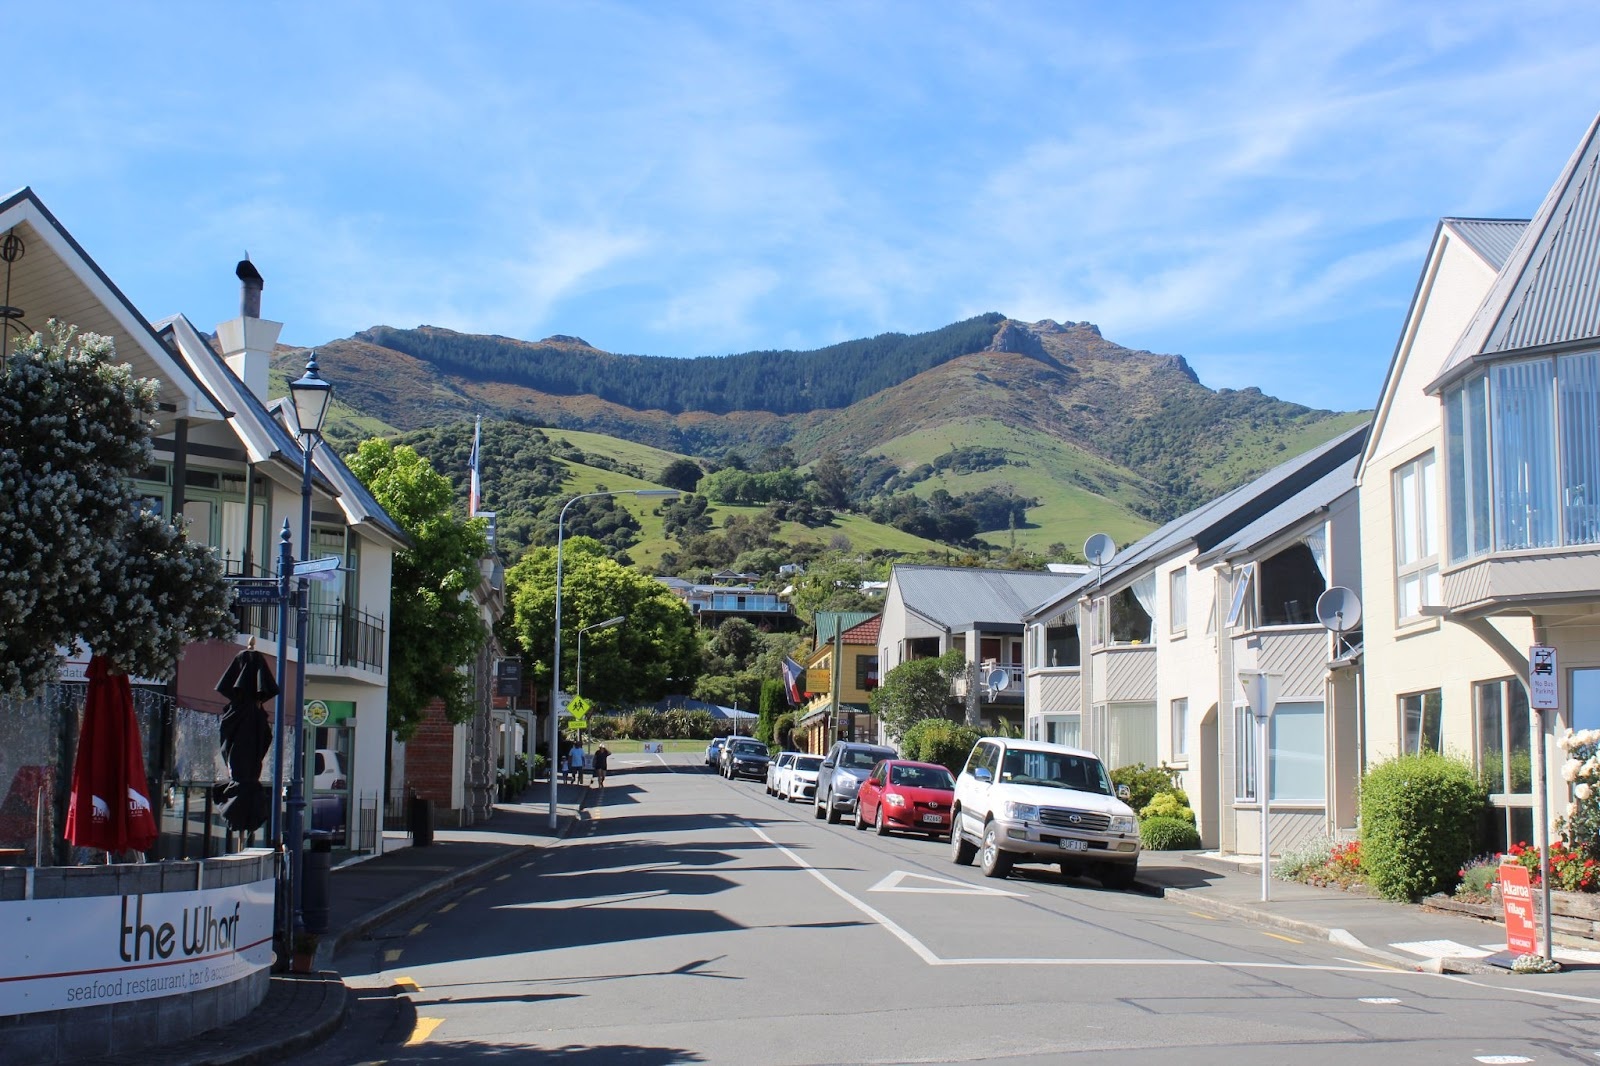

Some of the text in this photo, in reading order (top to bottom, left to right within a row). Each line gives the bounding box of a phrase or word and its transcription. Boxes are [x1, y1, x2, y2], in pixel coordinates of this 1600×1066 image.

[1060, 839, 1087, 850] BUF118
[1503, 880, 1530, 898] Akaroa
[1506, 902, 1526, 919] Village
[120, 896, 240, 962] the Wharf
[1522, 916, 1533, 929] Inn
[67, 977, 123, 1002] seafood
[126, 972, 188, 995] restaurant,
[189, 968, 203, 986] bar
[204, 966, 210, 983] &
